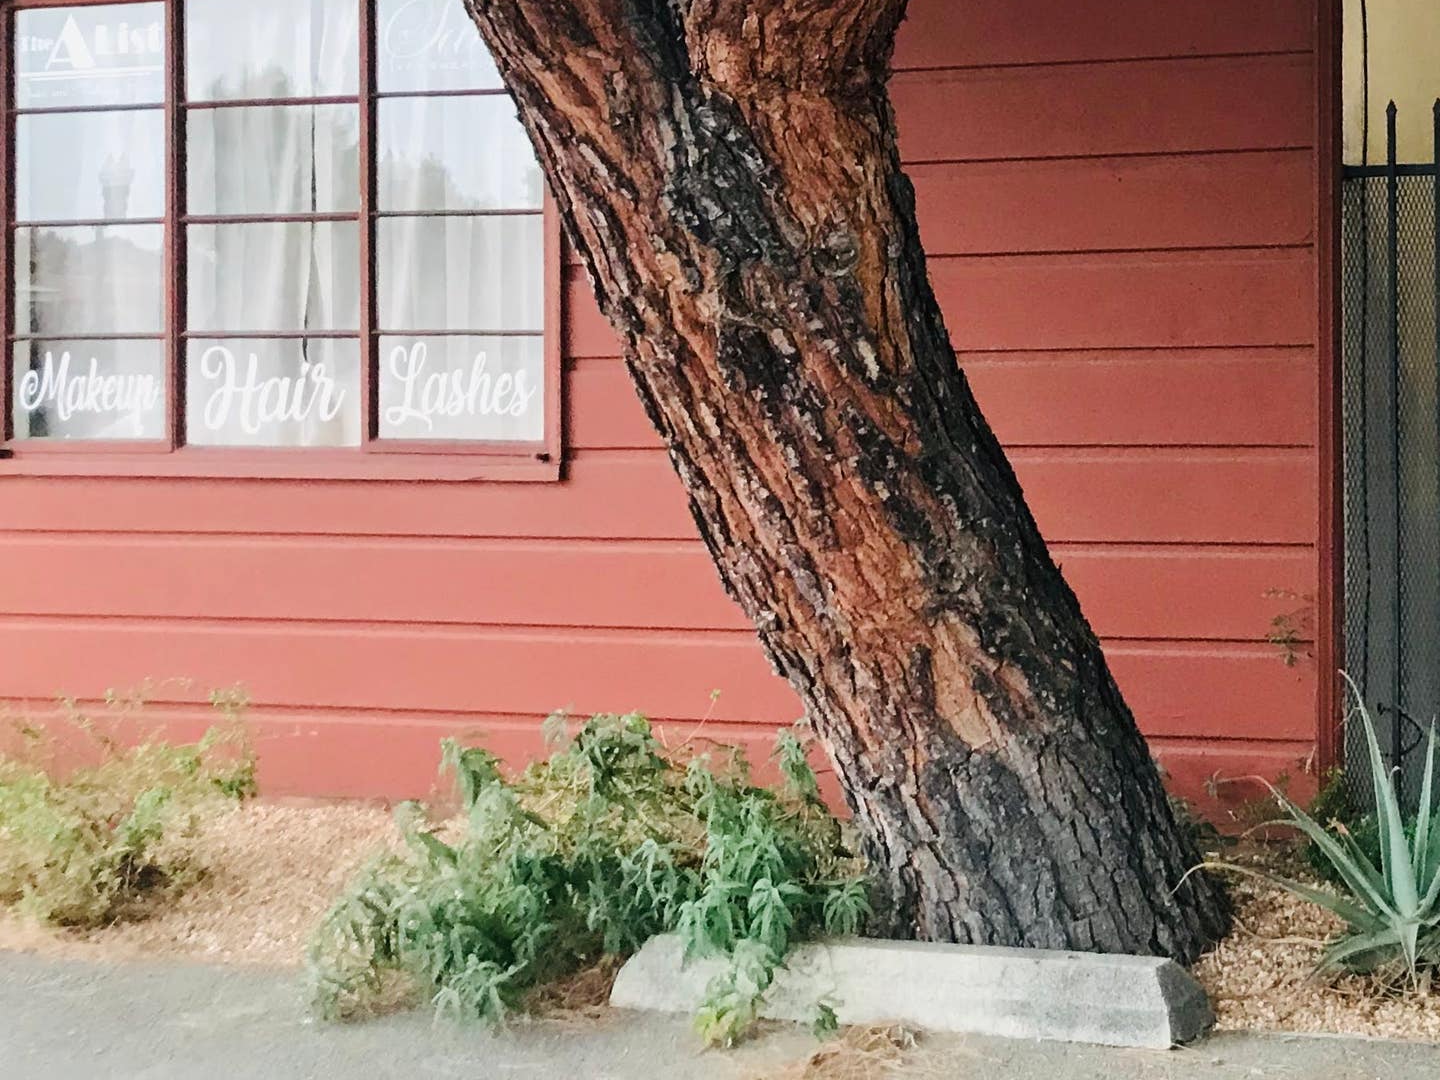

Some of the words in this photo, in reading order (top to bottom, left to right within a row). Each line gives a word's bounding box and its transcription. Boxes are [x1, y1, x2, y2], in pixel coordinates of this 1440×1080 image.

[45, 12, 97, 71] A
[19, 351, 159, 436] Makeup
[200, 345, 348, 434] Hair
[384, 341, 537, 432] Lashes
